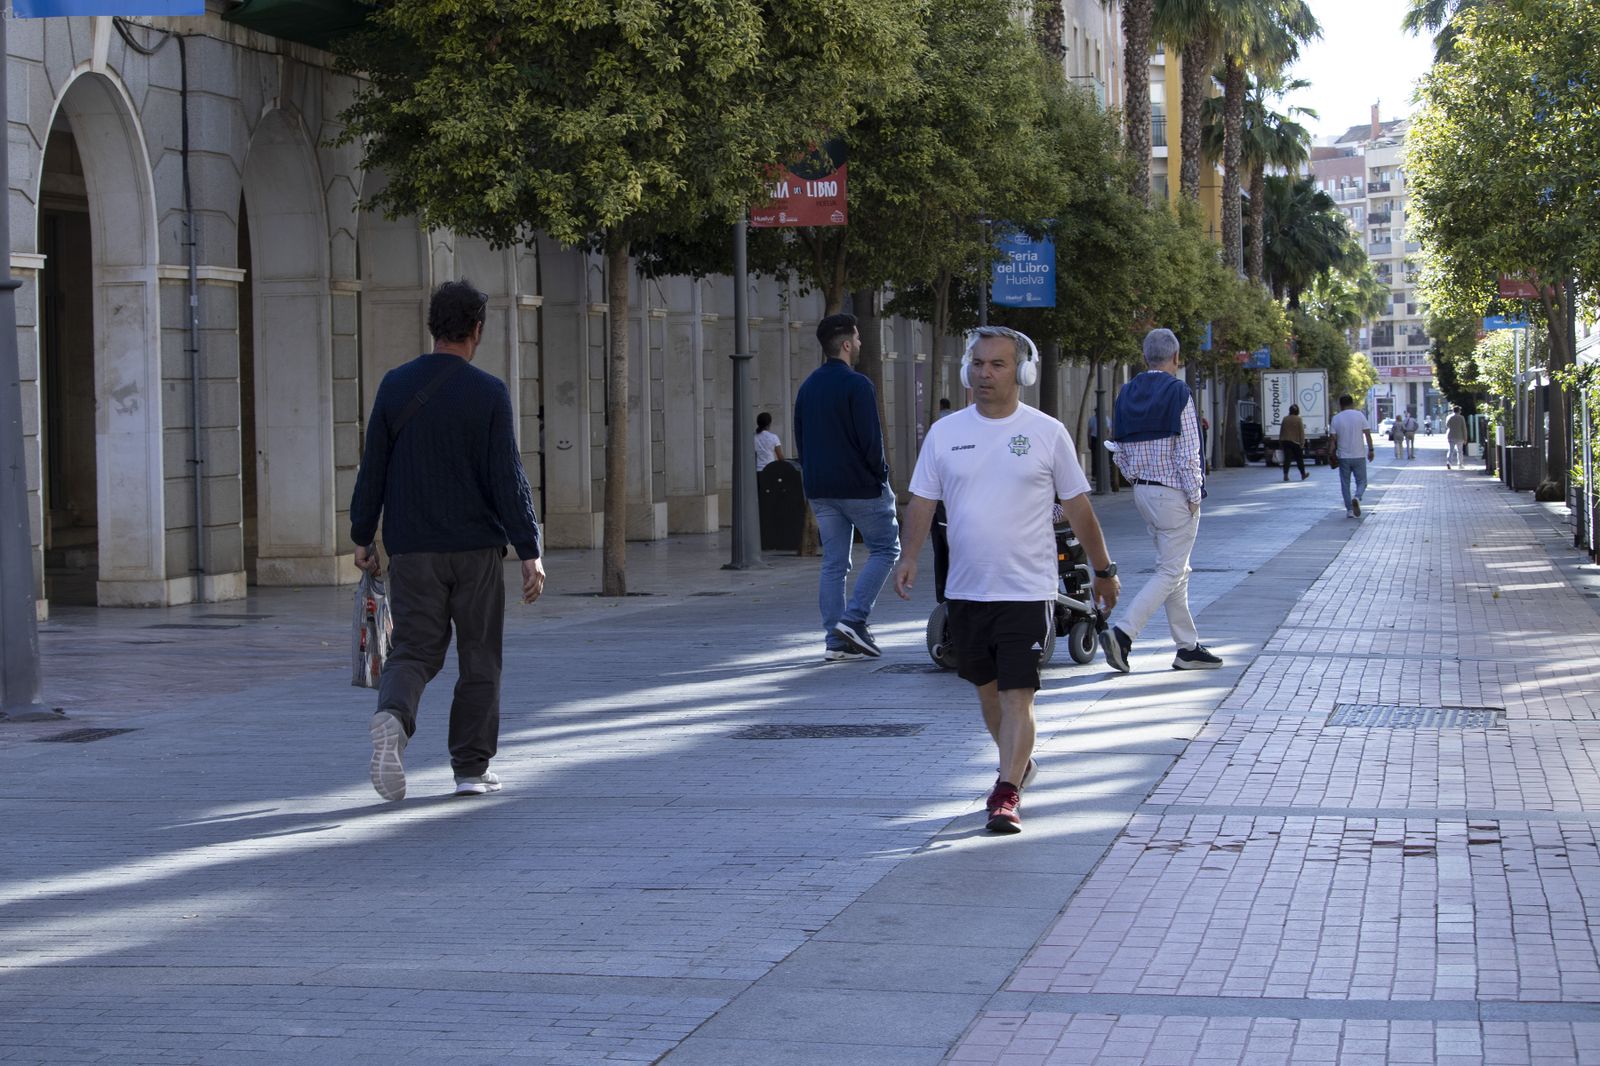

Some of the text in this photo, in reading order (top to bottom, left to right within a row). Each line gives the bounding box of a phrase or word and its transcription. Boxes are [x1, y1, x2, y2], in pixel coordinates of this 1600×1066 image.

[806, 181, 838, 198] LIBRO
[1008, 250, 1038, 261] Feria
[997, 262, 1049, 273] del Libro
[1006, 274, 1044, 285] Huelva
